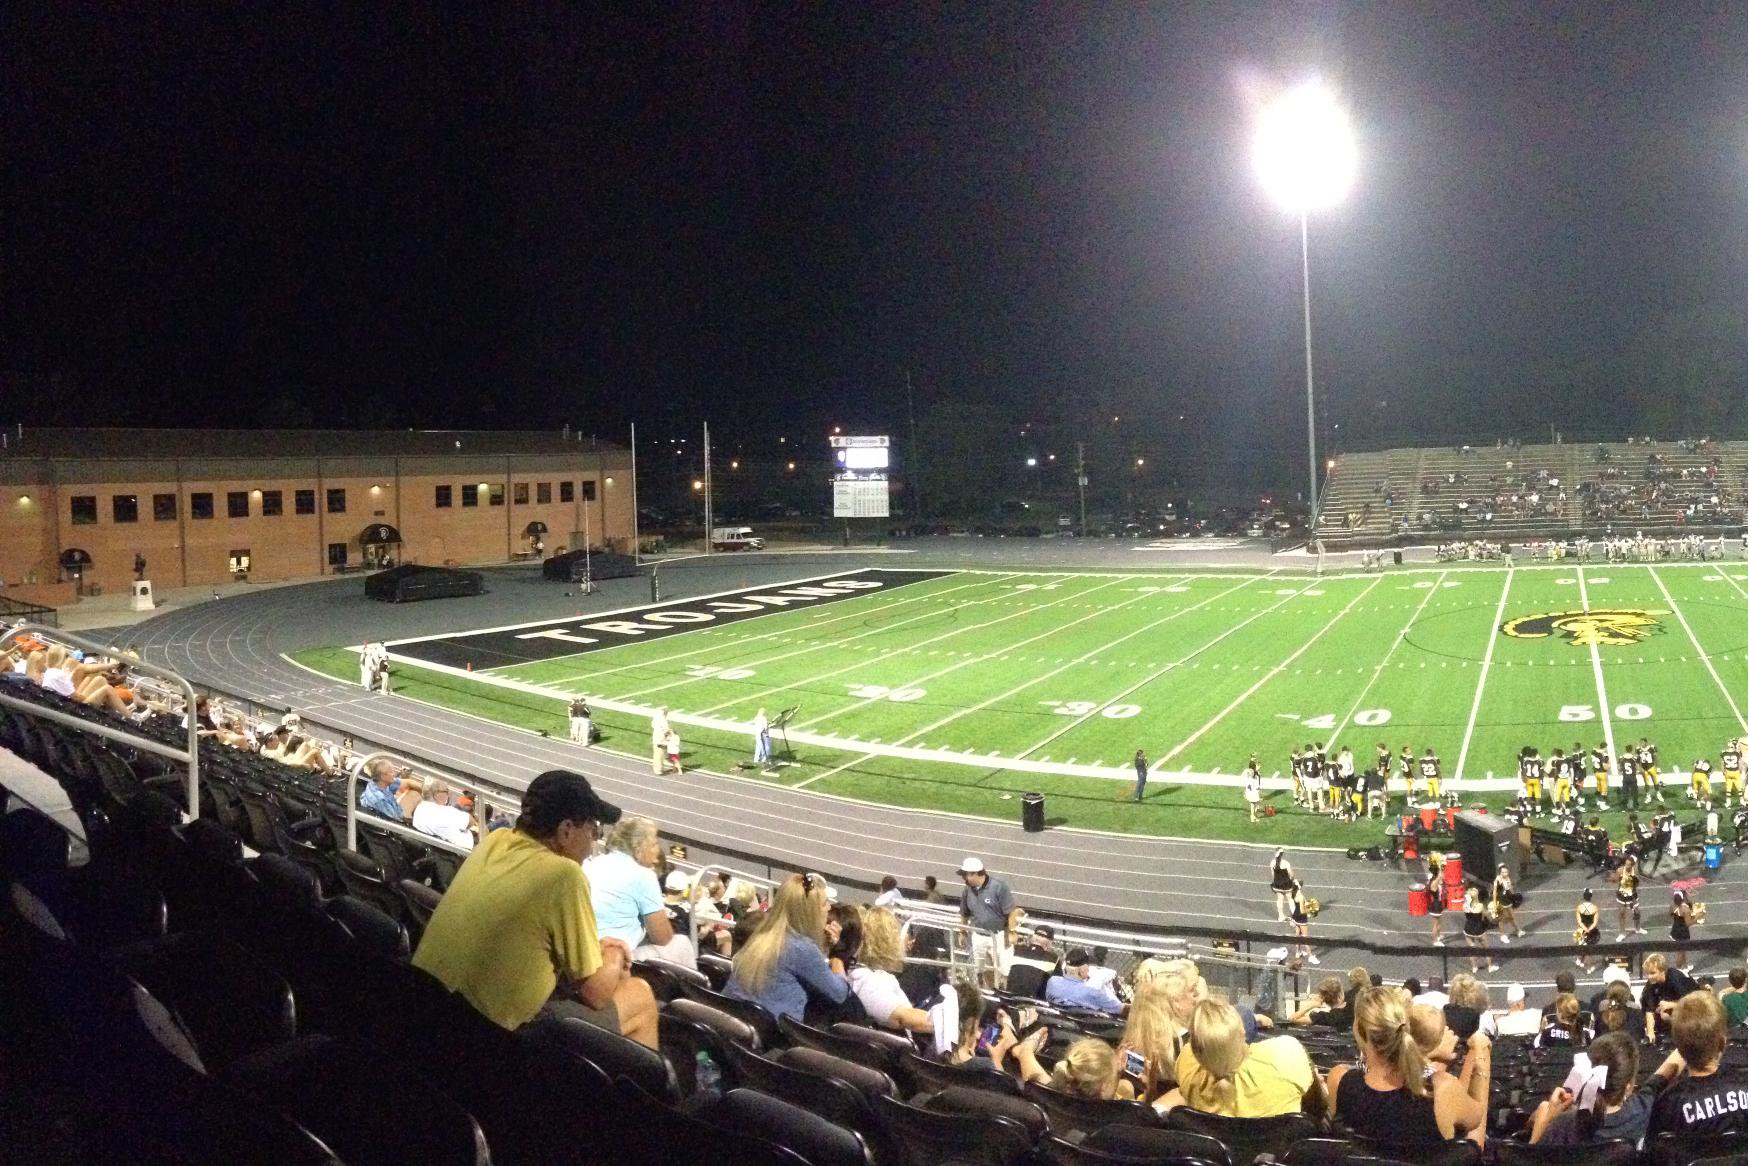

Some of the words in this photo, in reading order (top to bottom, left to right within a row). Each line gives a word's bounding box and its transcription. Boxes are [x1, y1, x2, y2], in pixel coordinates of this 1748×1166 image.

[515, 580, 884, 644] TROJANS
[1301, 709, 1392, 728] 40
[1558, 703, 1653, 721] 50
[1306, 761, 1313, 772] 7
